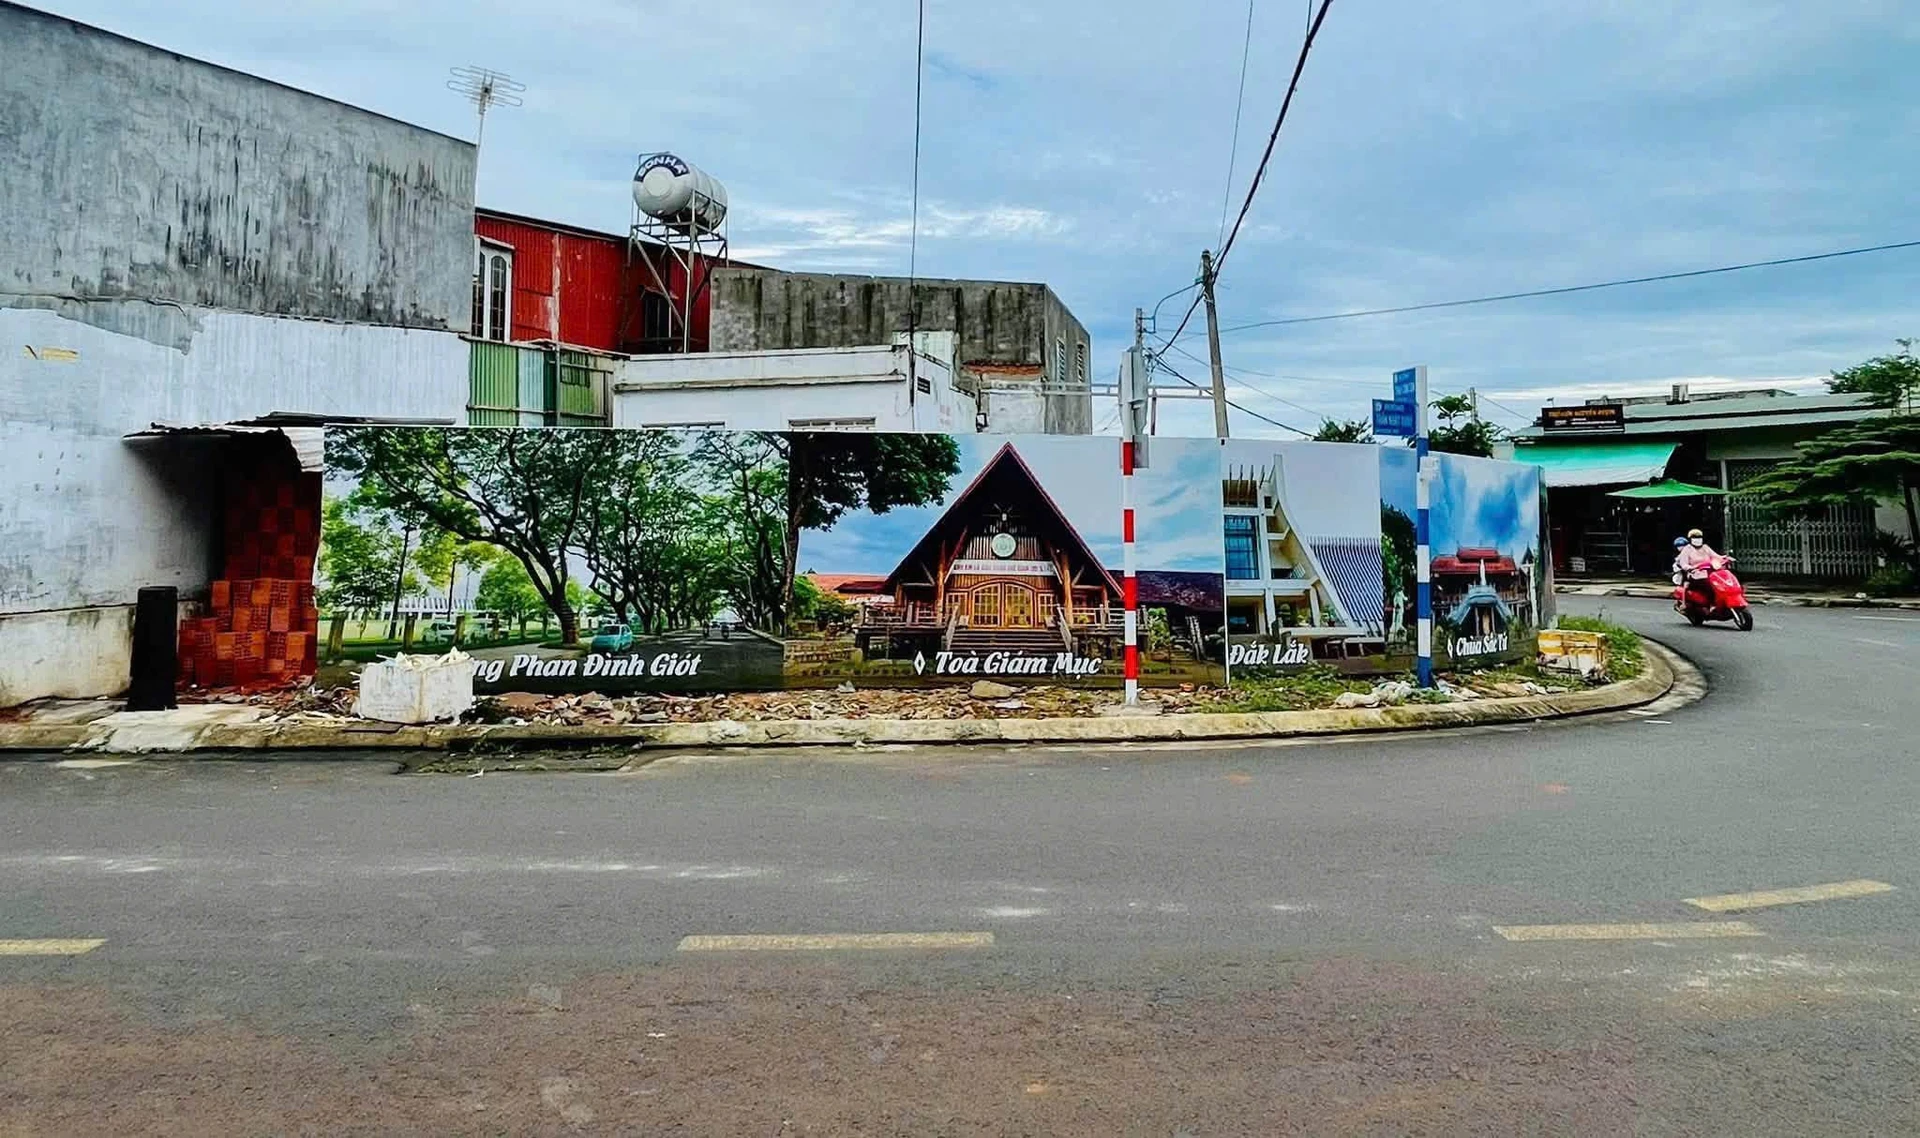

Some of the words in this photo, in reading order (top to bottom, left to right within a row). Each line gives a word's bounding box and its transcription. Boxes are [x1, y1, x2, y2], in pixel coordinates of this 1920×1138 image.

[1229, 640, 1270, 665] Đắk
[1272, 639, 1309, 665] Lắk
[1456, 635, 1482, 657] Chùa
[509, 654, 578, 677] Phan
[582, 652, 645, 677] Đình
[650, 652, 702, 677] Giót
[935, 650, 981, 675] Toà
[983, 650, 1047, 675] Giám
[1051, 652, 1102, 680] Mục
